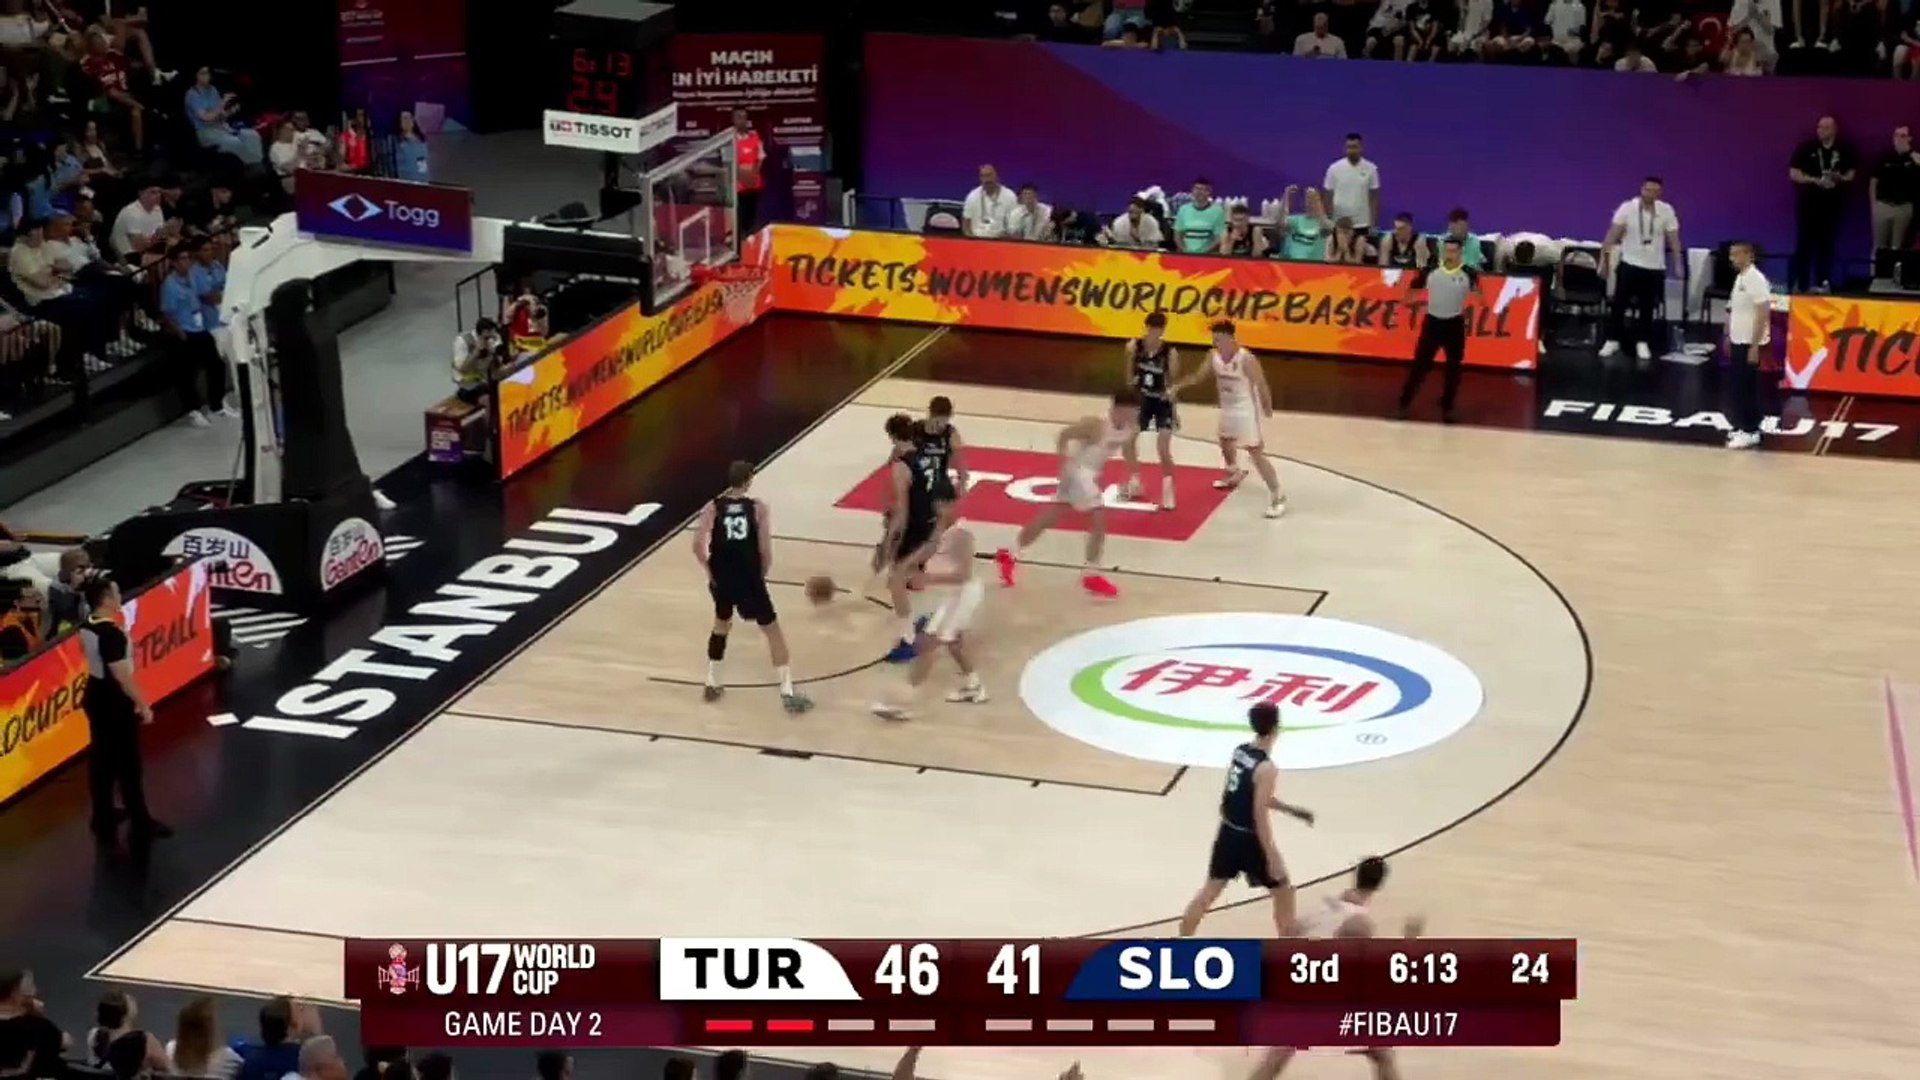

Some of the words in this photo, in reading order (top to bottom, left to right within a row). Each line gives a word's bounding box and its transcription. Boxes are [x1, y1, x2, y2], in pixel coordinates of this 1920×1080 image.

[696, 68, 721, 86] İYİ
[725, 64, 818, 86] HAREKETİ
[711, 51, 773, 67] MAÇIN
[574, 122, 632, 138] TISSOT
[384, 200, 440, 227] Togg
[787, 254, 1511, 337] TICKETS.WOMENSWORLDCUP.BASKETALL
[1829, 327, 1920, 376] TIC
[1544, 400, 1734, 431] FIBA
[1759, 416, 1900, 442] U17
[723, 516, 748, 541] 13
[207, 503, 663, 739] İSTANBUL
[1119, 659, 1379, 713] 伊利
